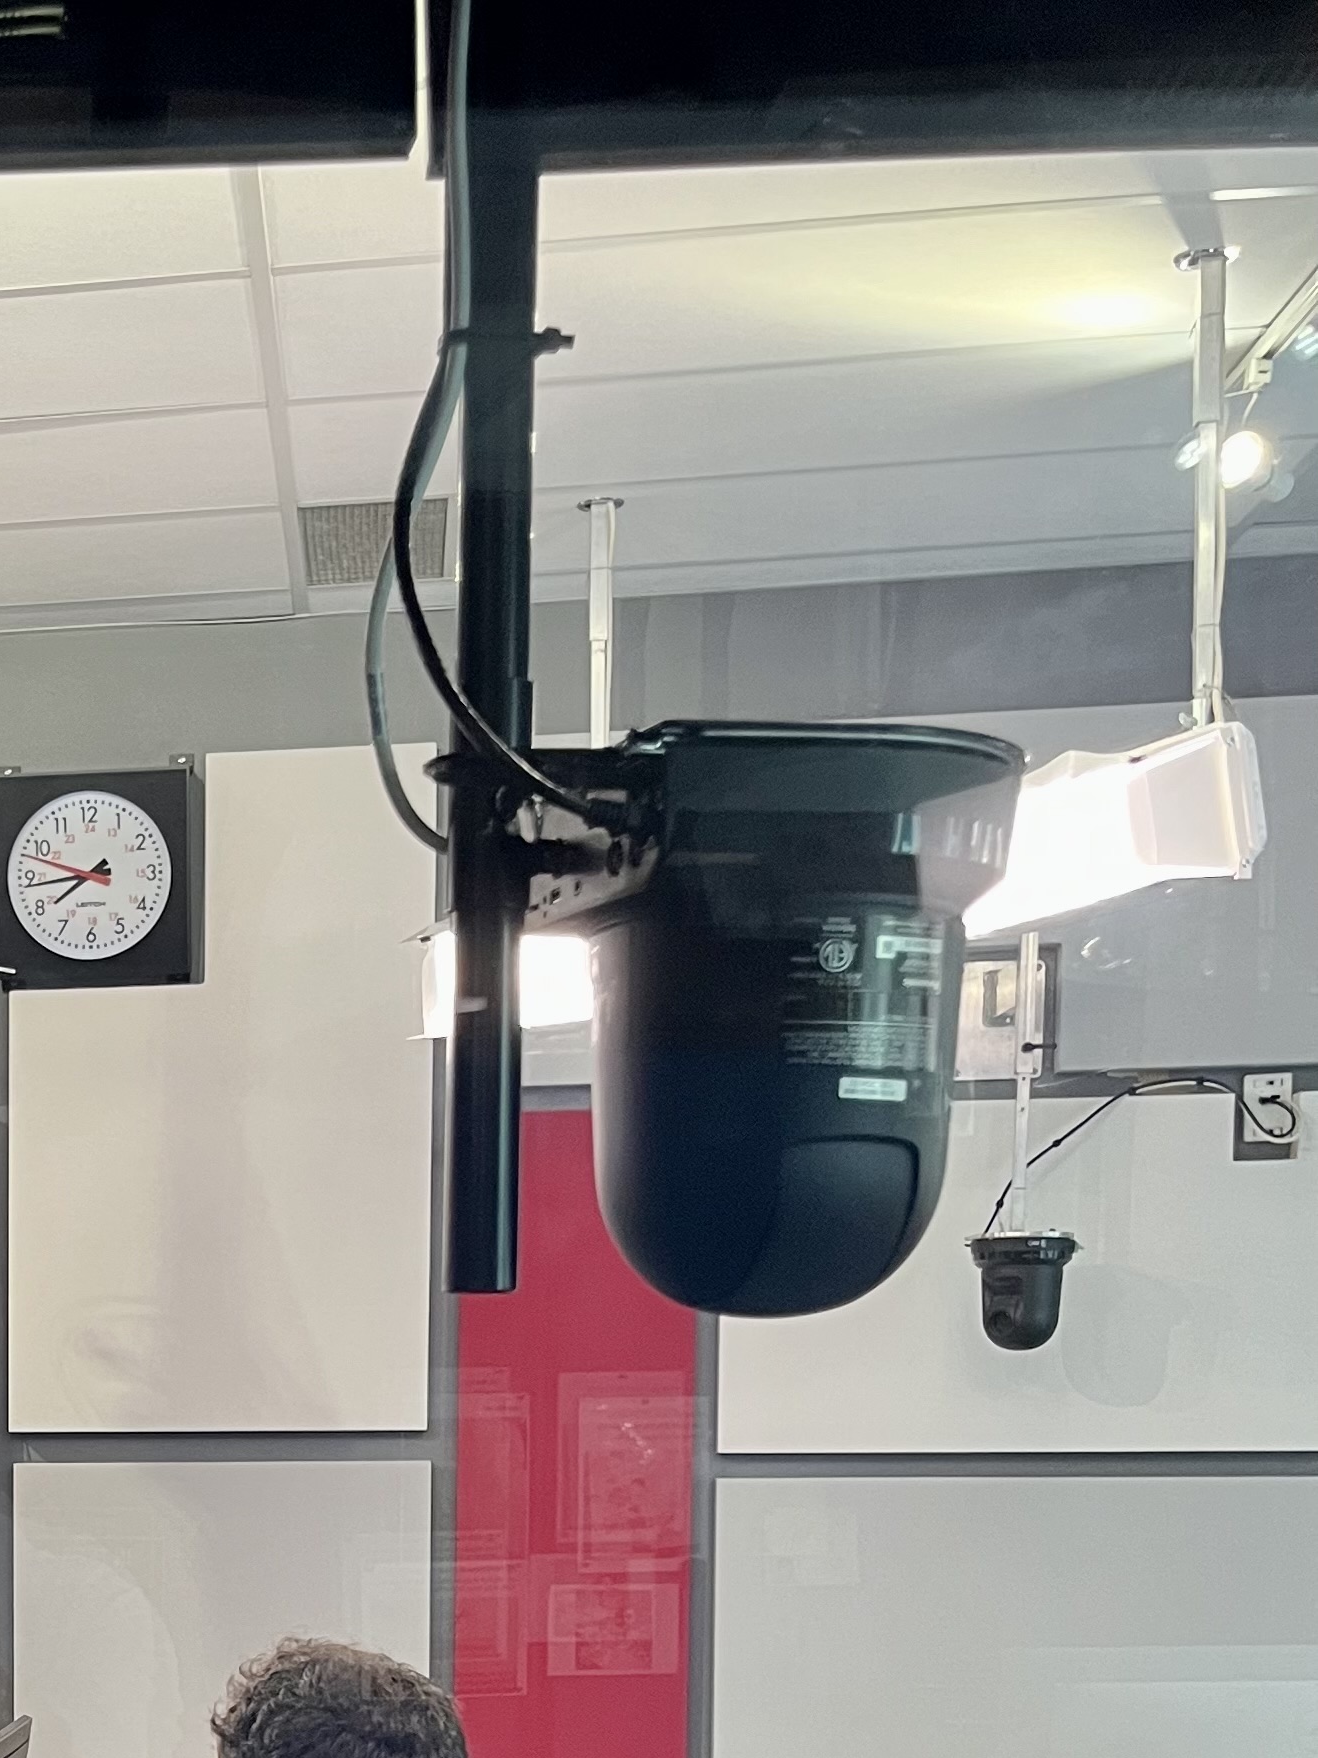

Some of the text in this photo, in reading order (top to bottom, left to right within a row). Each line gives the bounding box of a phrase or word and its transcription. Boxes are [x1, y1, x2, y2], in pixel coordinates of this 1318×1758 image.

[80, 805, 98, 824] 12
[115, 812, 121, 830] 1
[54, 816, 67, 835] 11
[64, 834, 75, 844] 23
[124, 843, 135, 852] 14
[135, 833, 146, 851] 2
[34, 839, 51, 857] 10
[50, 850, 61, 860] 22
[24, 869, 36, 887] 9
[146, 863, 157, 881] 3
[35, 899, 45, 916] 8
[136, 895, 147, 911] 4
[66, 909, 77, 918] 19
[57, 919, 69, 936] 7
[114, 917, 125, 934] 5
[86, 926, 97, 943] 6
